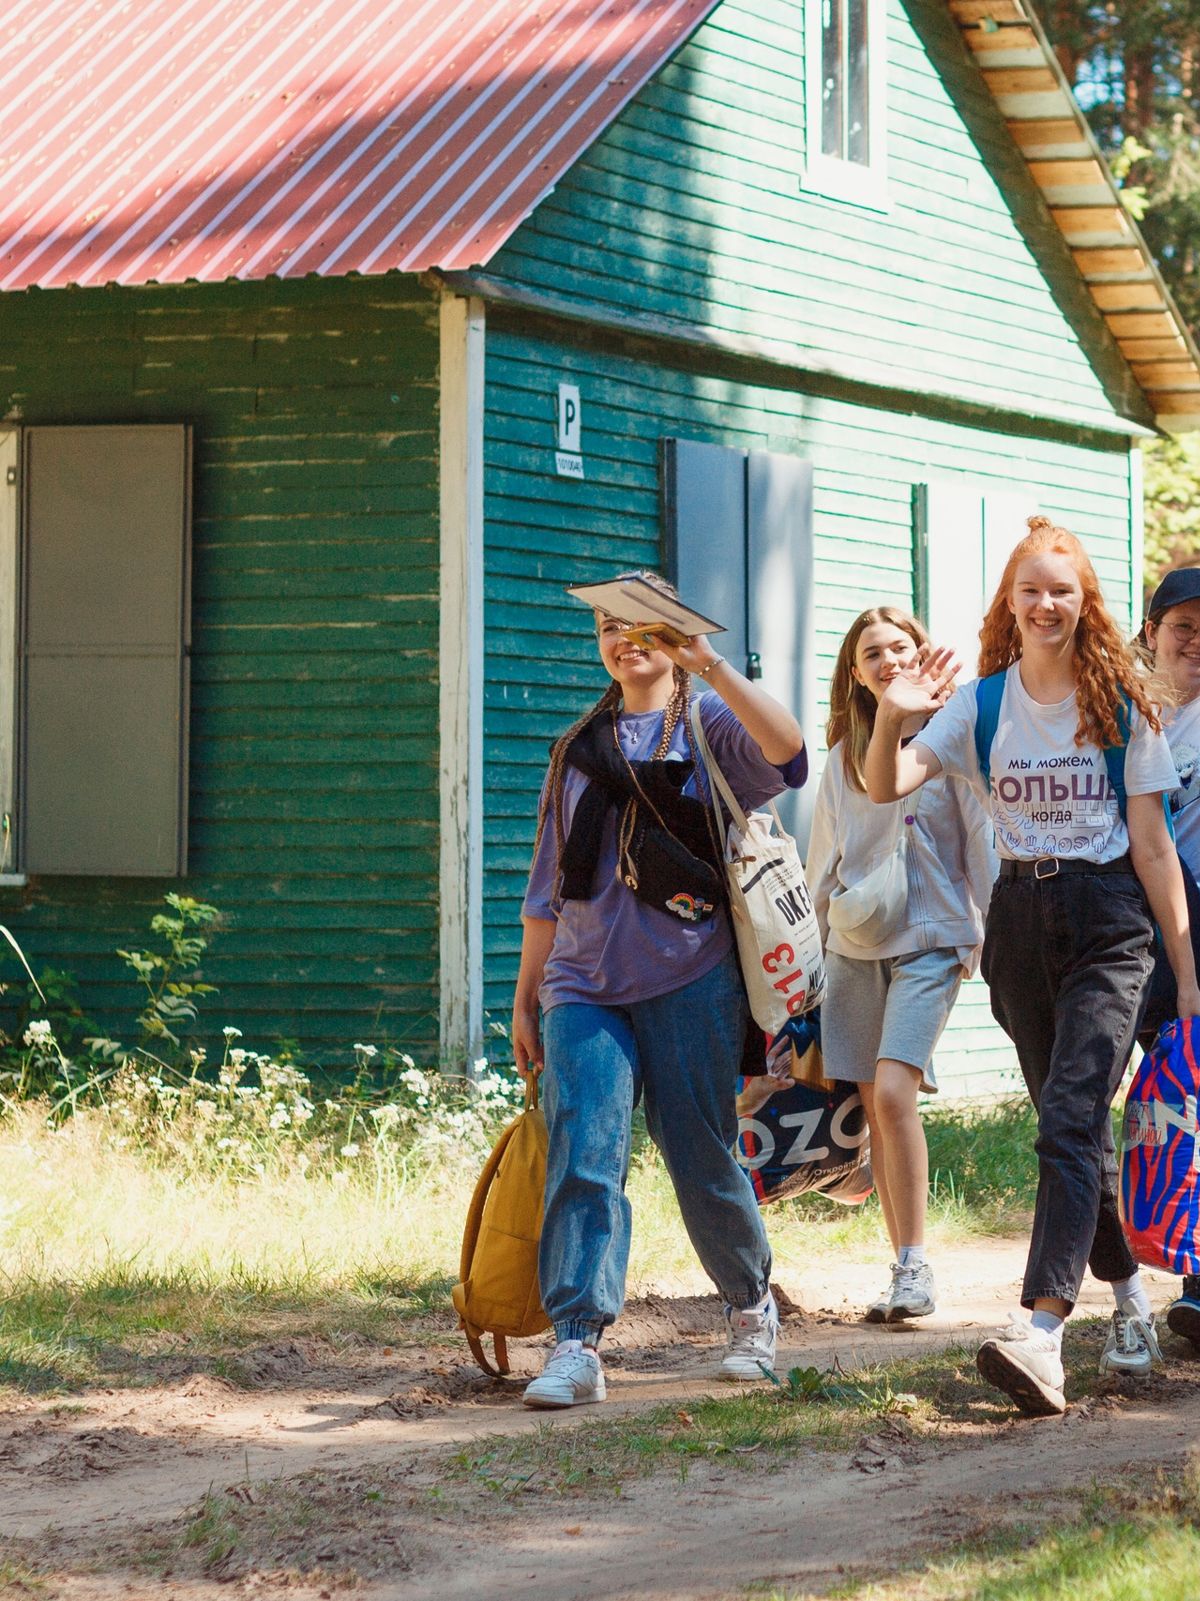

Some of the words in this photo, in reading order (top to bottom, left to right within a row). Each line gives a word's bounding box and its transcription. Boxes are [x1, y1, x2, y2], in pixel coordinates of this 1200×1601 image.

[1008, 758, 1032, 770] мы
[1036, 755, 1094, 769] можем
[1031, 810, 1072, 824] когда
